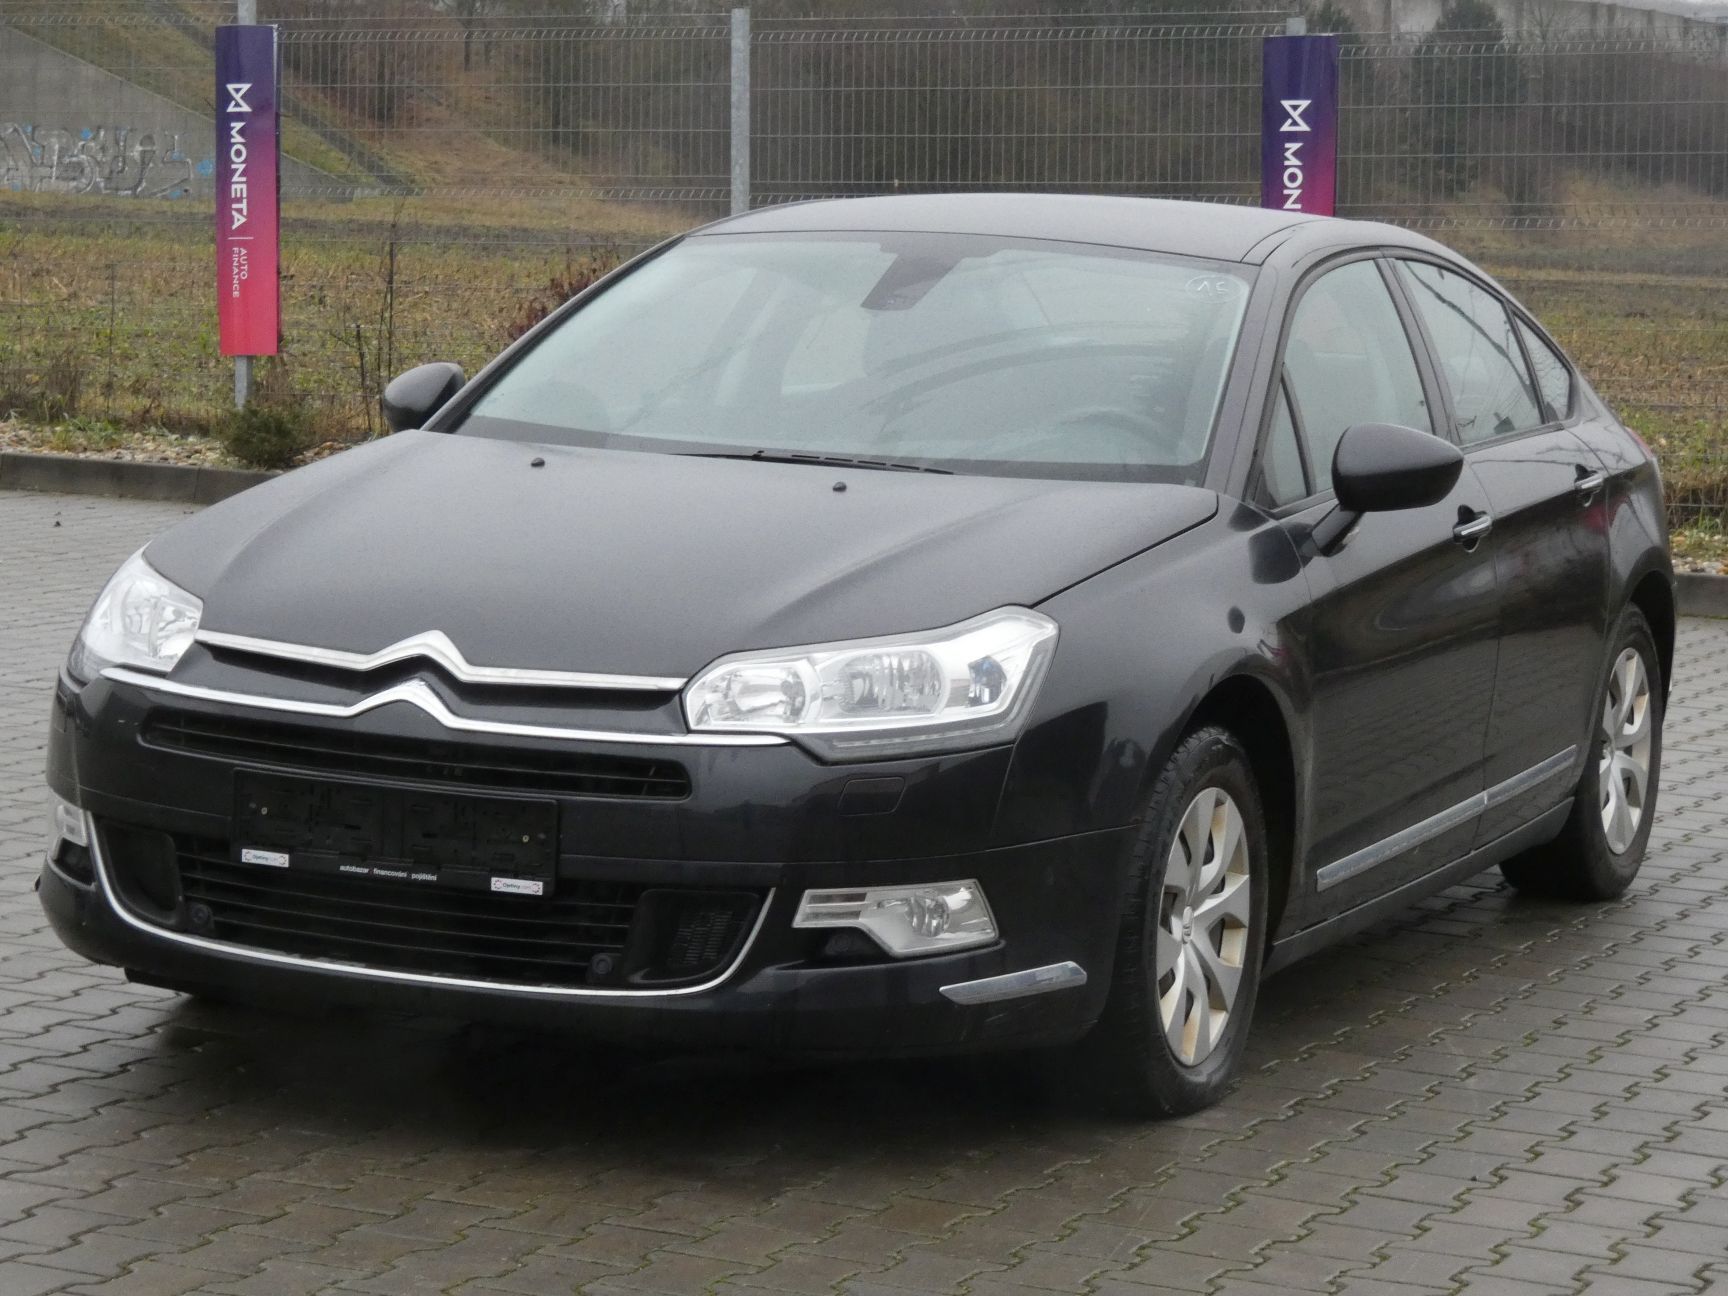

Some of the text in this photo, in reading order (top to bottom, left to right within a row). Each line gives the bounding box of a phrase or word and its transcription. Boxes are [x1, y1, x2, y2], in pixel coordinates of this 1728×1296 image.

[230, 121, 247, 230] MONETA
[1283, 143, 1303, 209] MON
[232, 247, 240, 298] FINANCE
[240, 247, 248, 280] AUTO
